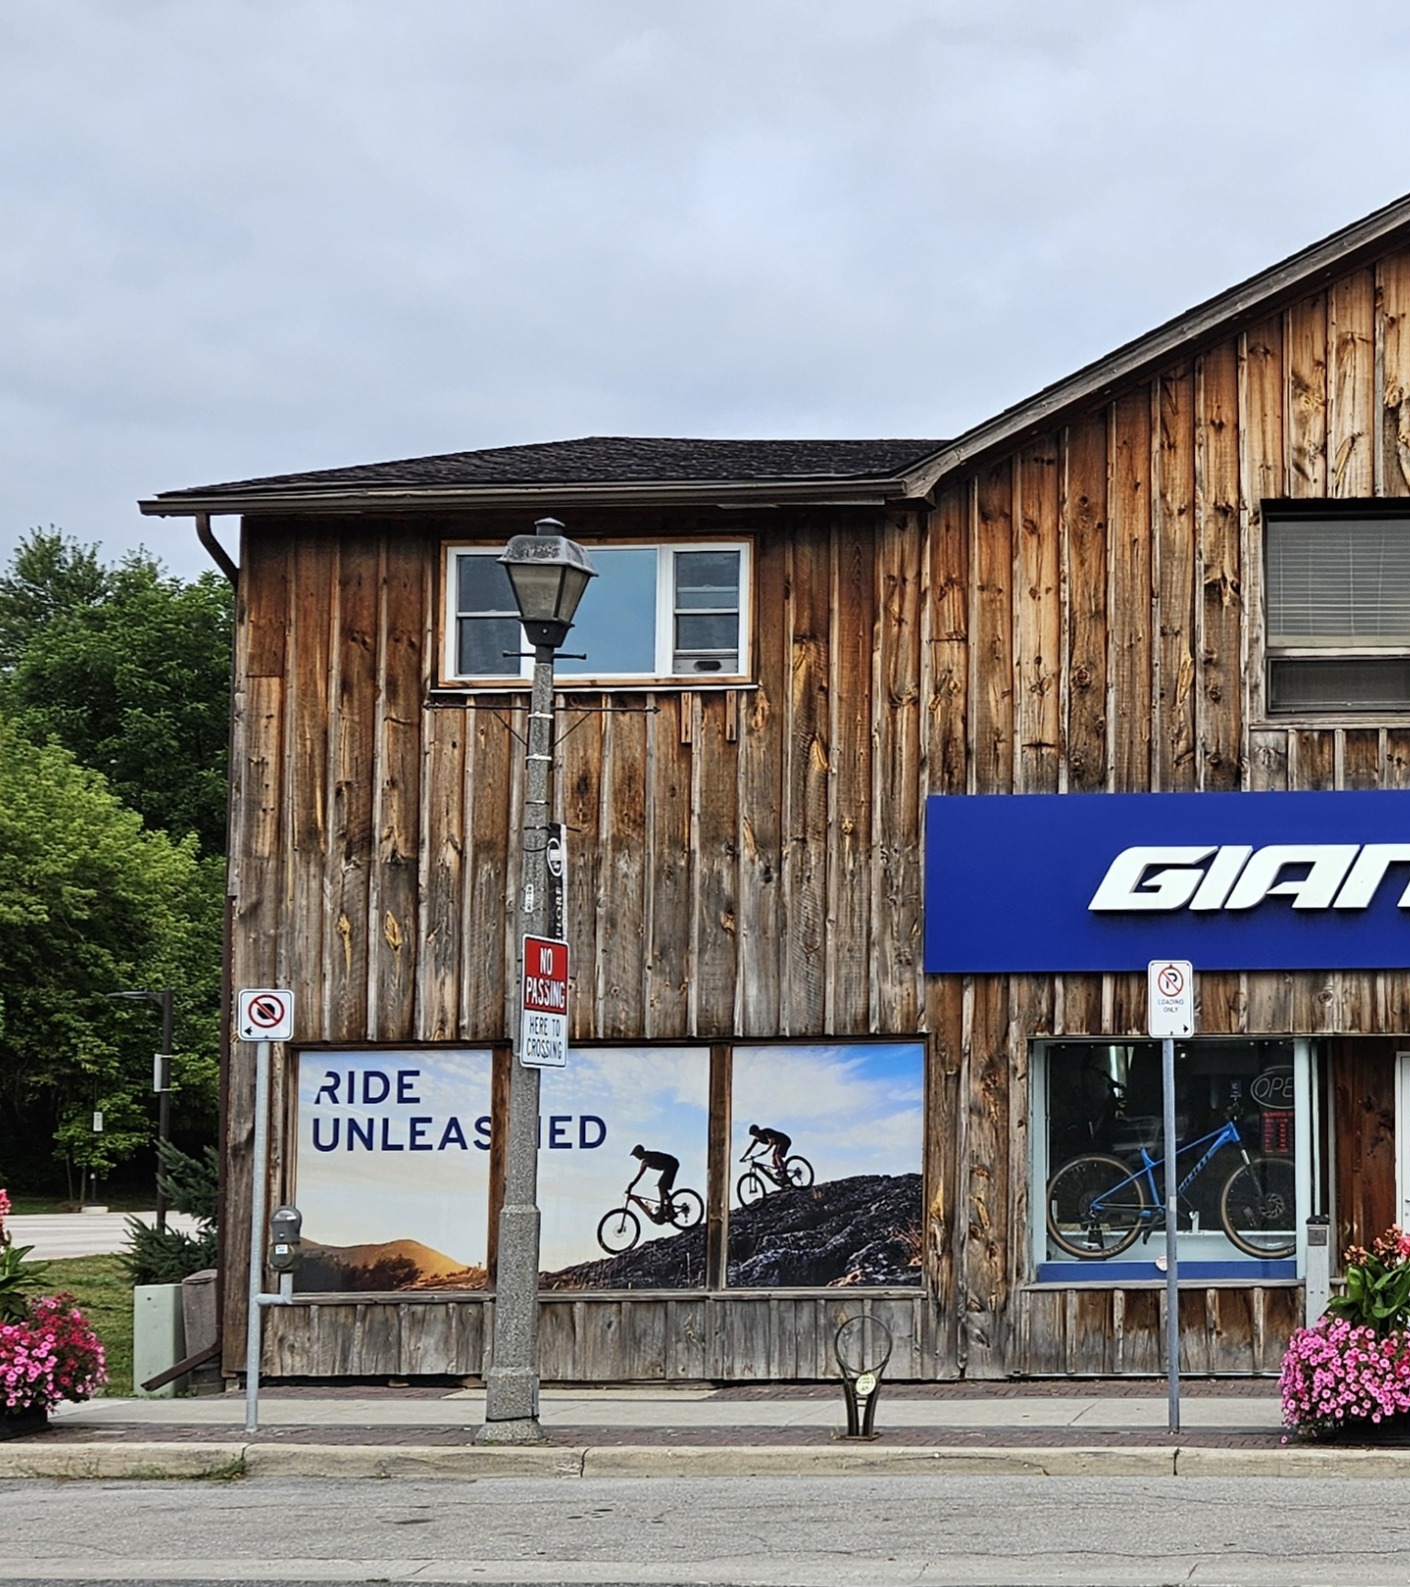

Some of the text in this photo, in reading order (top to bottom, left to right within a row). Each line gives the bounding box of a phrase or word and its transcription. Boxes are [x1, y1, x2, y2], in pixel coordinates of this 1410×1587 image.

[540, 947, 553, 976] NO
[526, 976, 565, 1009] PASSING
[529, 1016, 561, 1037] HERE TO
[526, 1038, 562, 1059] CROSSING
[314, 1070, 421, 1105] RIDE
[1255, 1077, 1293, 1098] OPE
[312, 1115, 607, 1152] UNLEASED
